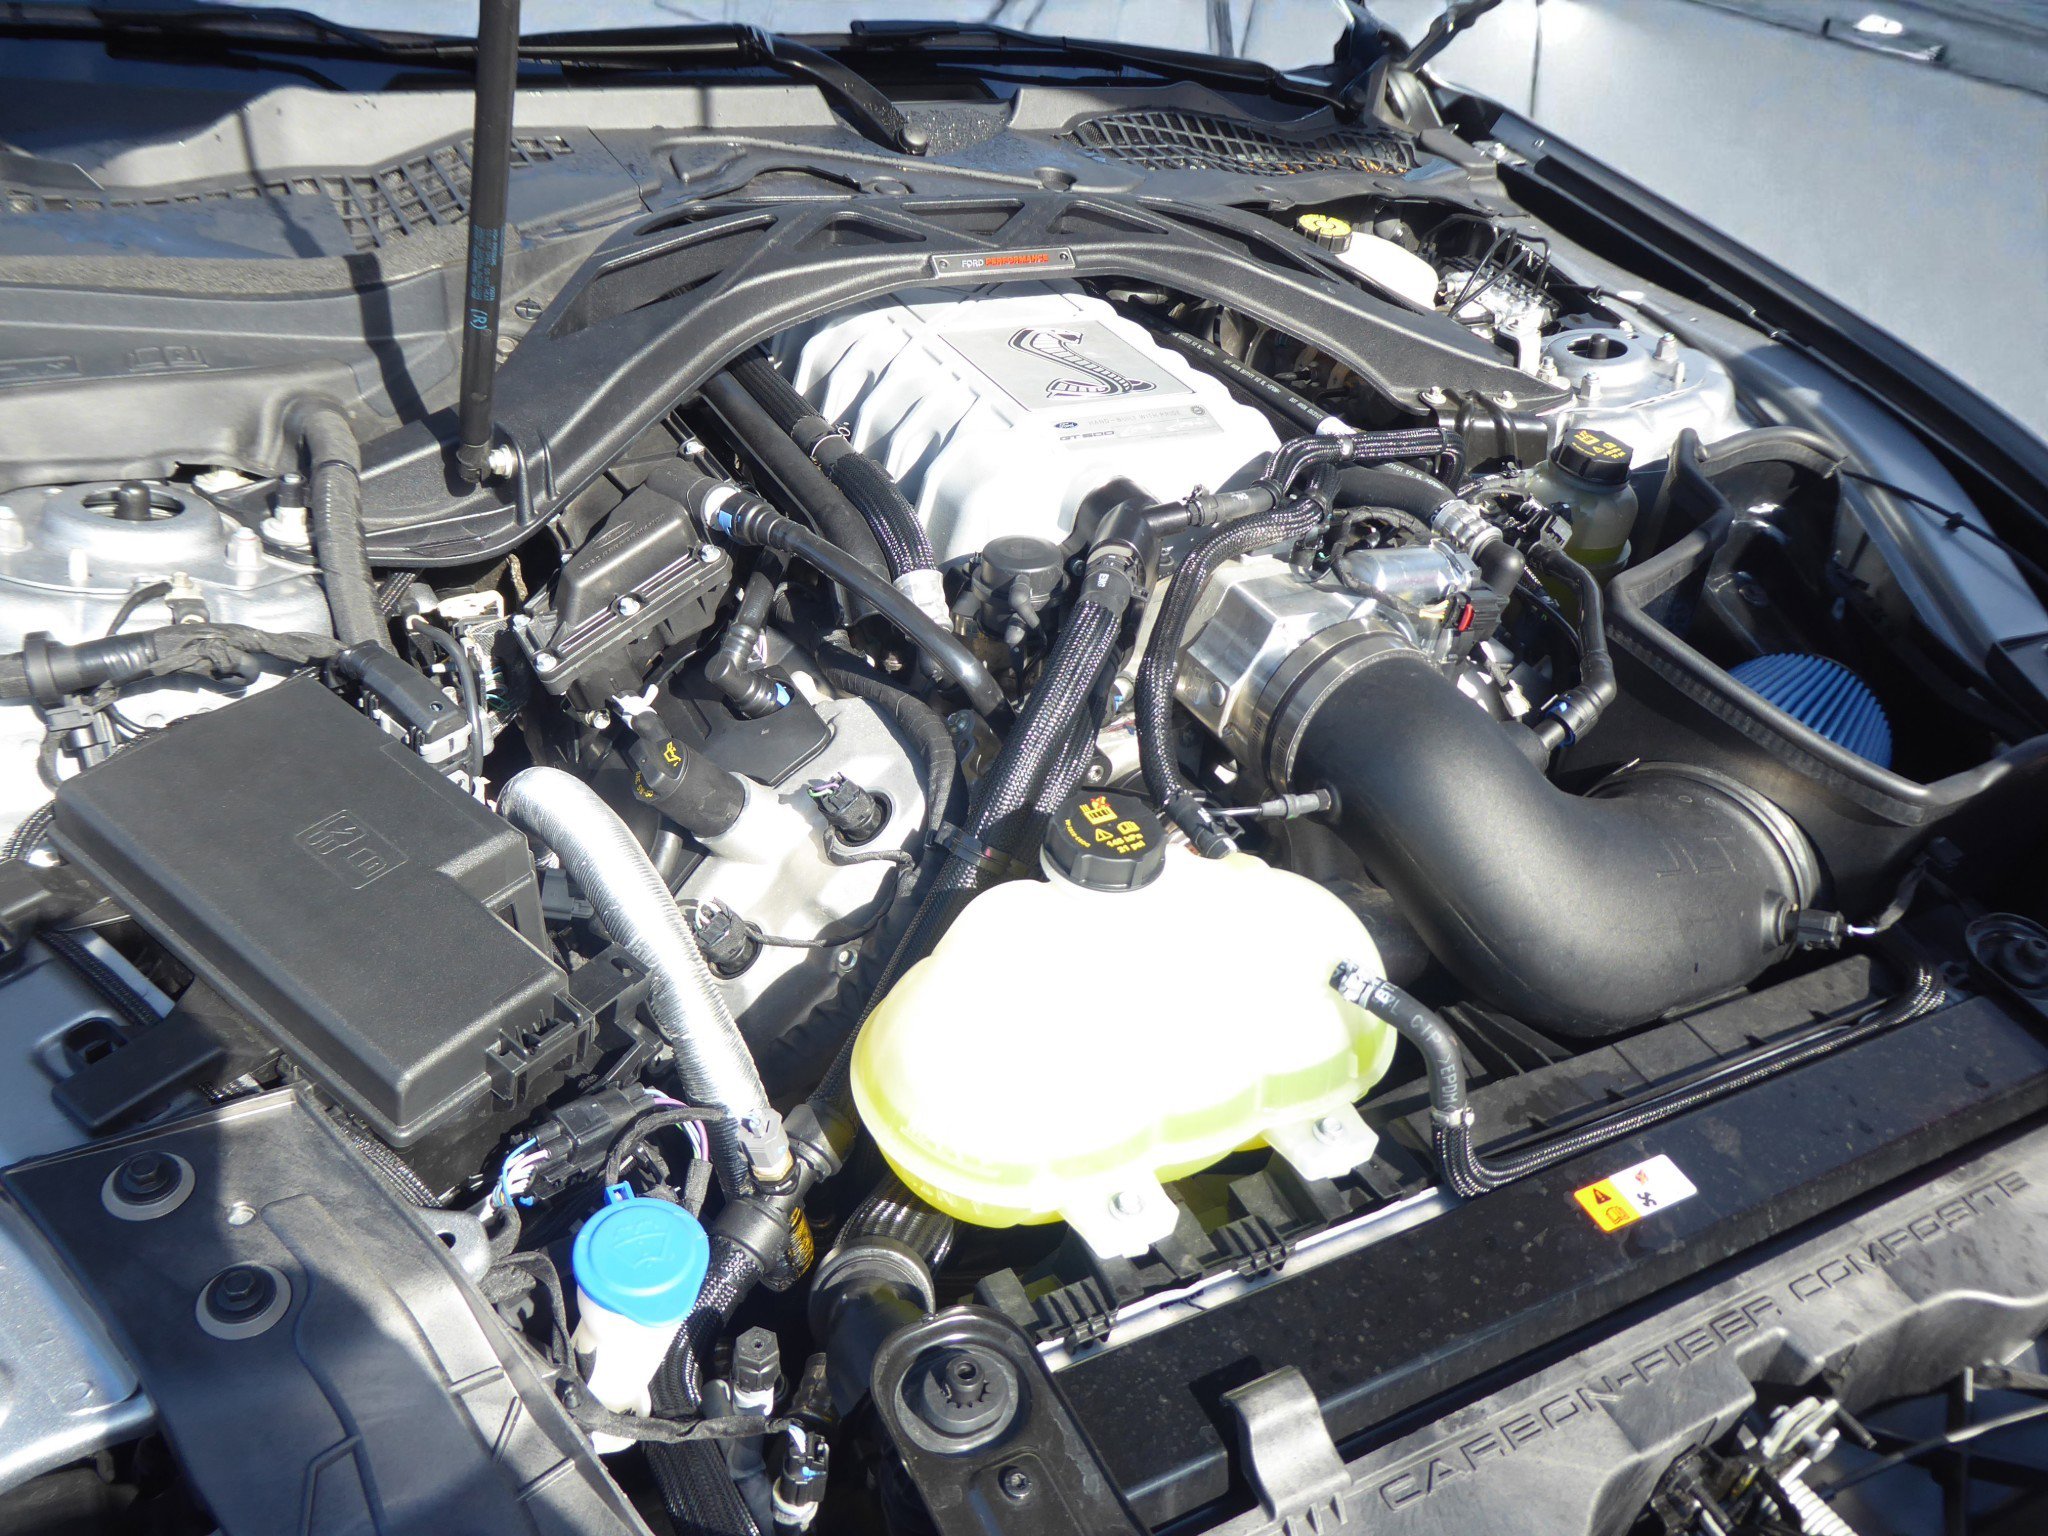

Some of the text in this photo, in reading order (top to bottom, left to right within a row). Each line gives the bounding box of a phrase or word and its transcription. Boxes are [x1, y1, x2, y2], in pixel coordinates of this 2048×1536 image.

[961, 253, 1049, 269] FORD PERFORMANCE
[1788, 1170, 2031, 1304] COMPOSITE
[1379, 1295, 1783, 1512] CARBON-FIBER
